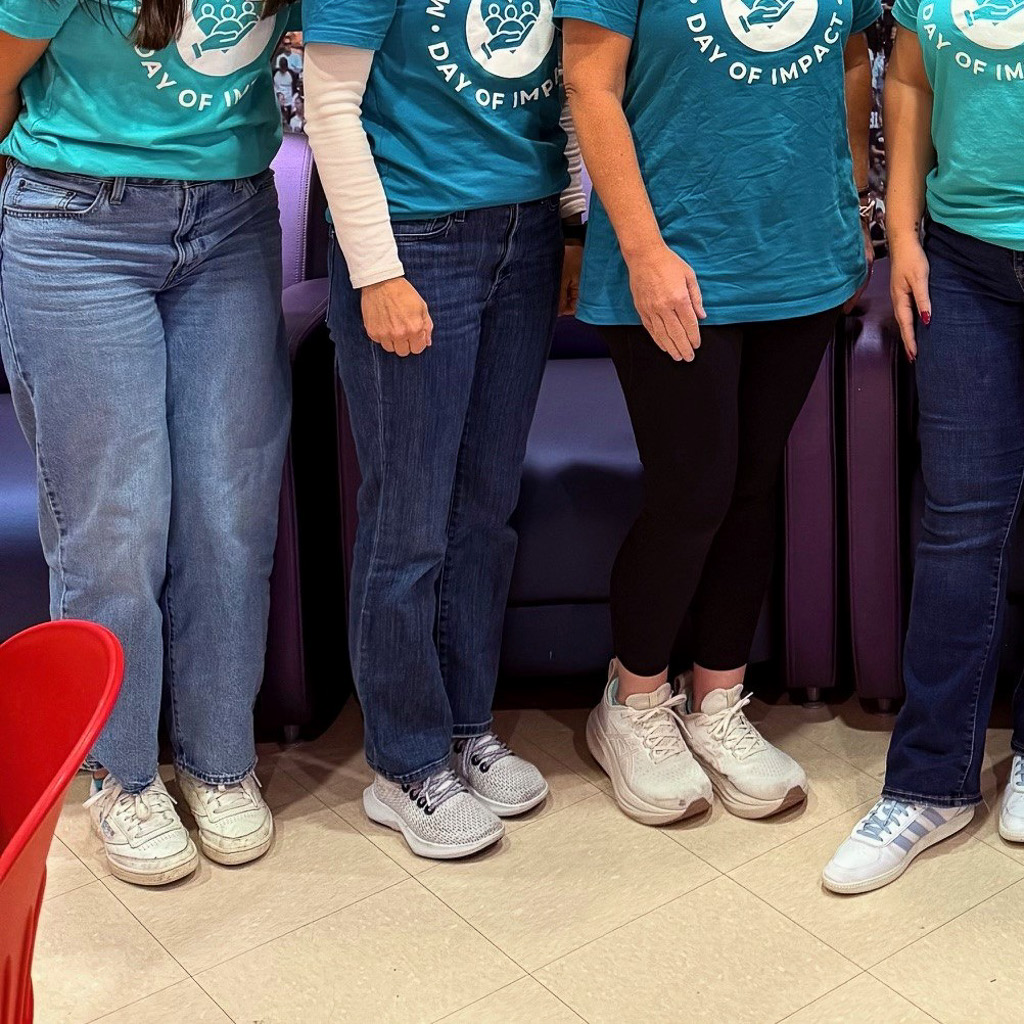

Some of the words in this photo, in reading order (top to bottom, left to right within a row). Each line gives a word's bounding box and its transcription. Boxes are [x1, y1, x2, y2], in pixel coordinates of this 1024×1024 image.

[686, 12, 728, 63] DAY
[729, 61, 763, 86] OF
[771, 11, 844, 86] IMPACT
[922, 3, 951, 51] DAY
[955, 51, 987, 76] OF
[178, 89, 214, 112] OF
[427, 41, 472, 93] DAY
[475, 88, 505, 110] OF
